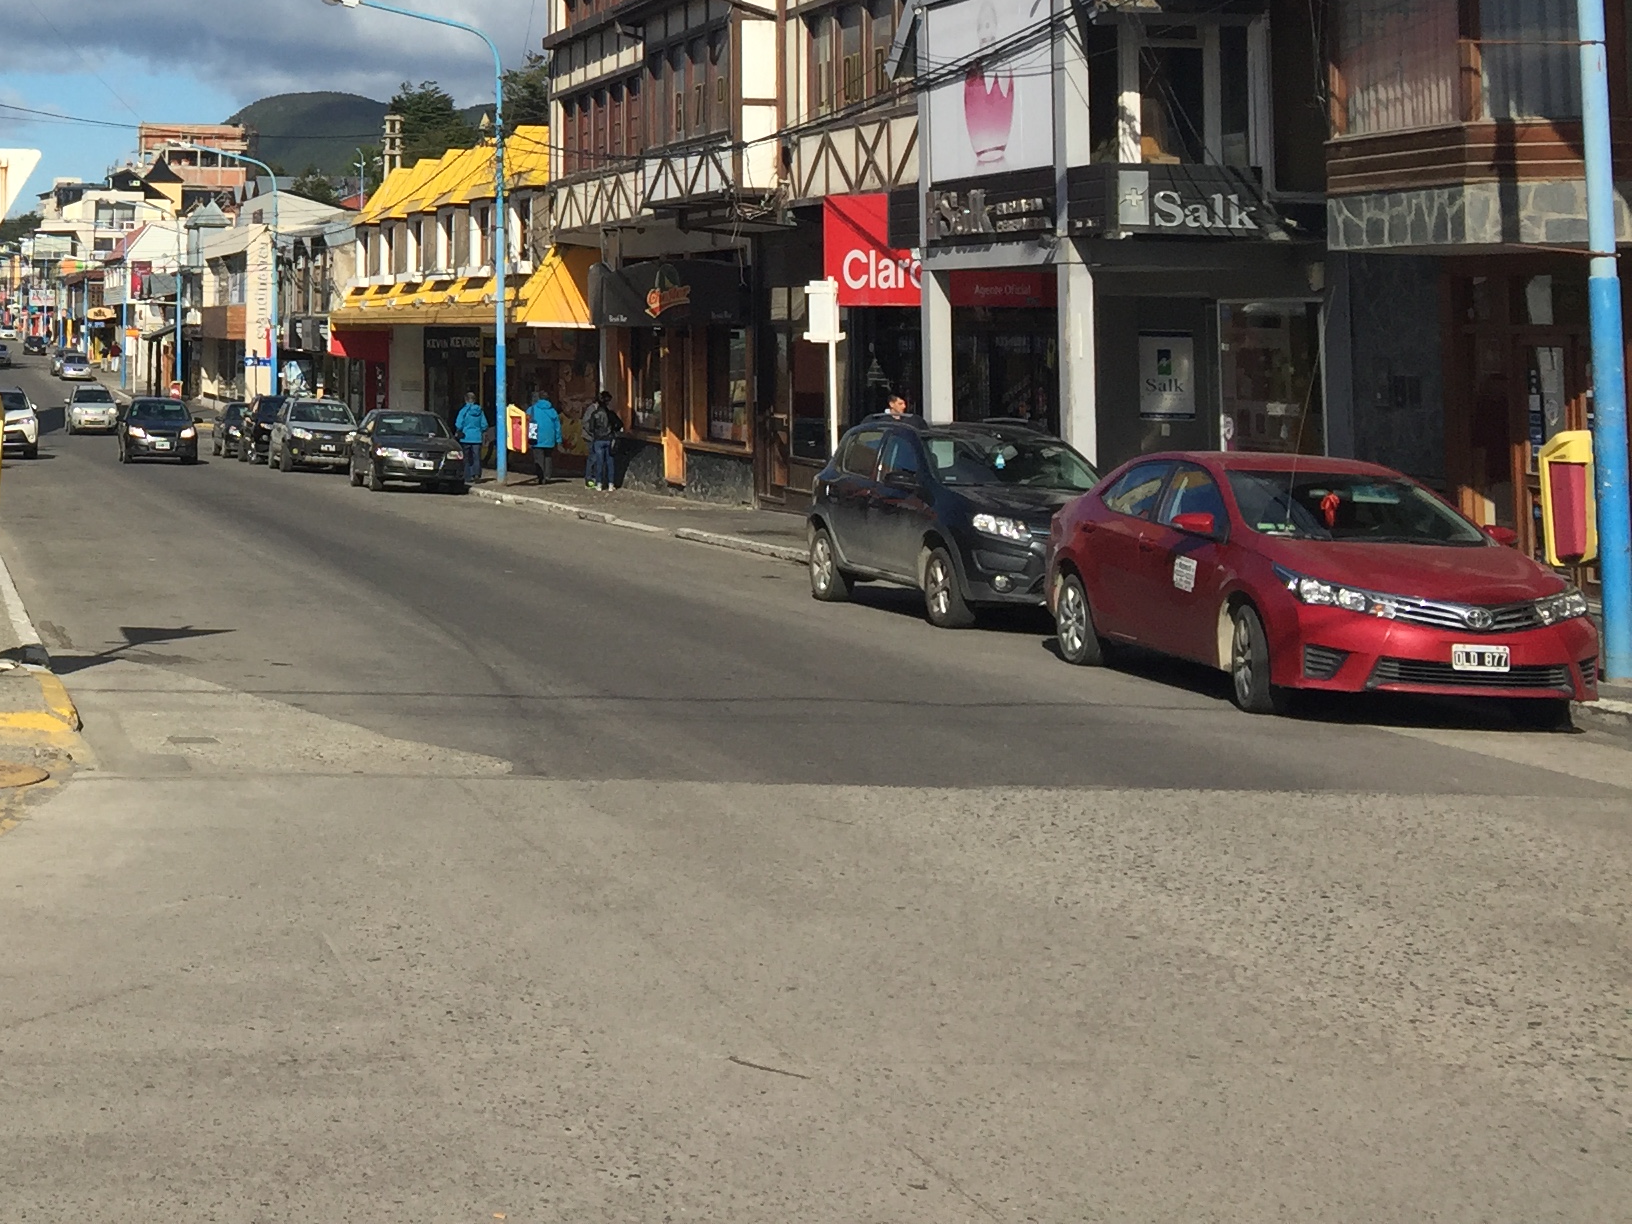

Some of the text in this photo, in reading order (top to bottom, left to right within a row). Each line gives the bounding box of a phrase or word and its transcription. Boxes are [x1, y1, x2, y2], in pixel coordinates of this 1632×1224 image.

[1154, 190, 1259, 230] Salk
[843, 249, 922, 290] Claro
[1145, 378, 1184, 393] Salk
[1484, 652, 1507, 667] 877
